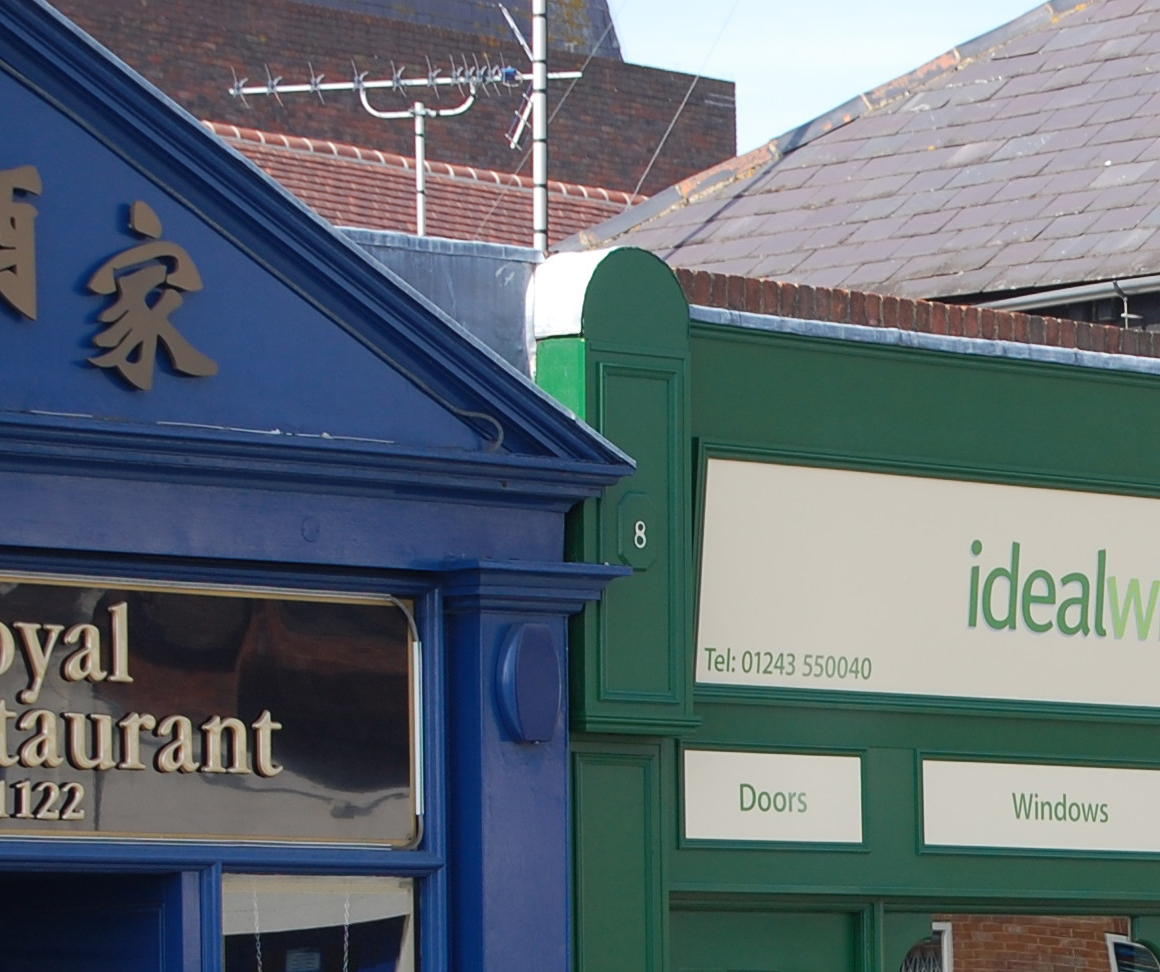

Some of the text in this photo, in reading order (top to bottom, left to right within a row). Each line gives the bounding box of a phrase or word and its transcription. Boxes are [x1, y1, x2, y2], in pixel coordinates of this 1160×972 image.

[634, 520, 647, 549] 8
[704, 647, 872, 680] Tel: 01243 550040
[739, 783, 807, 813] Doors
[1012, 792, 1109, 823] Windows
